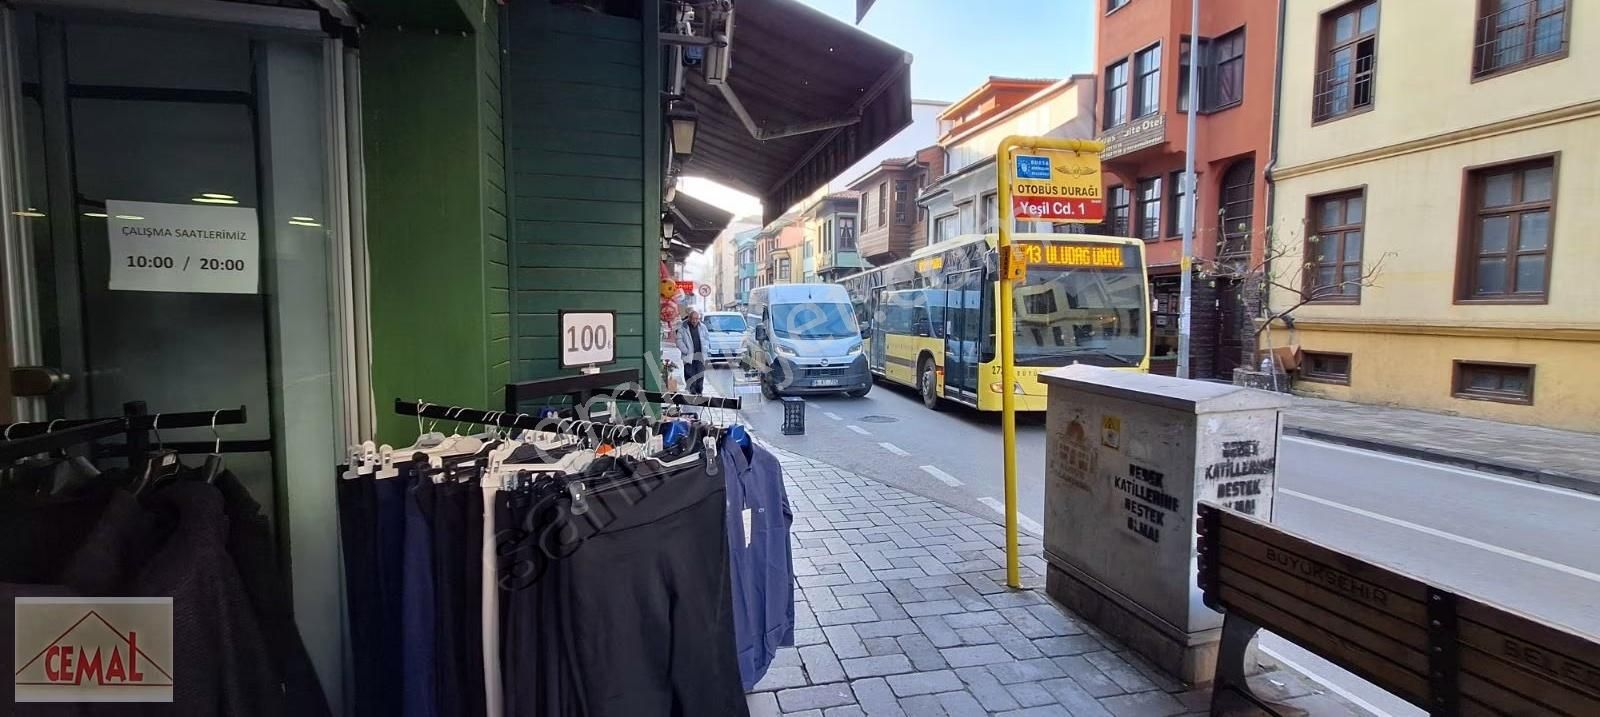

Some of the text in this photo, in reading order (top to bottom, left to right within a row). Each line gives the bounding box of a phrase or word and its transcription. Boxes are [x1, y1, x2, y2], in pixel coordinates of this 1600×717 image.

[1142, 116, 1163, 130] Otel
[1018, 183, 1098, 197] OTOBÜS DURAĞI
[1020, 201, 1085, 216] Yeşil Cd. 1
[121, 226, 247, 241] ÇALIŞMA SAATLERİMİZ
[127, 255, 244, 272] 10:00 / 20:00
